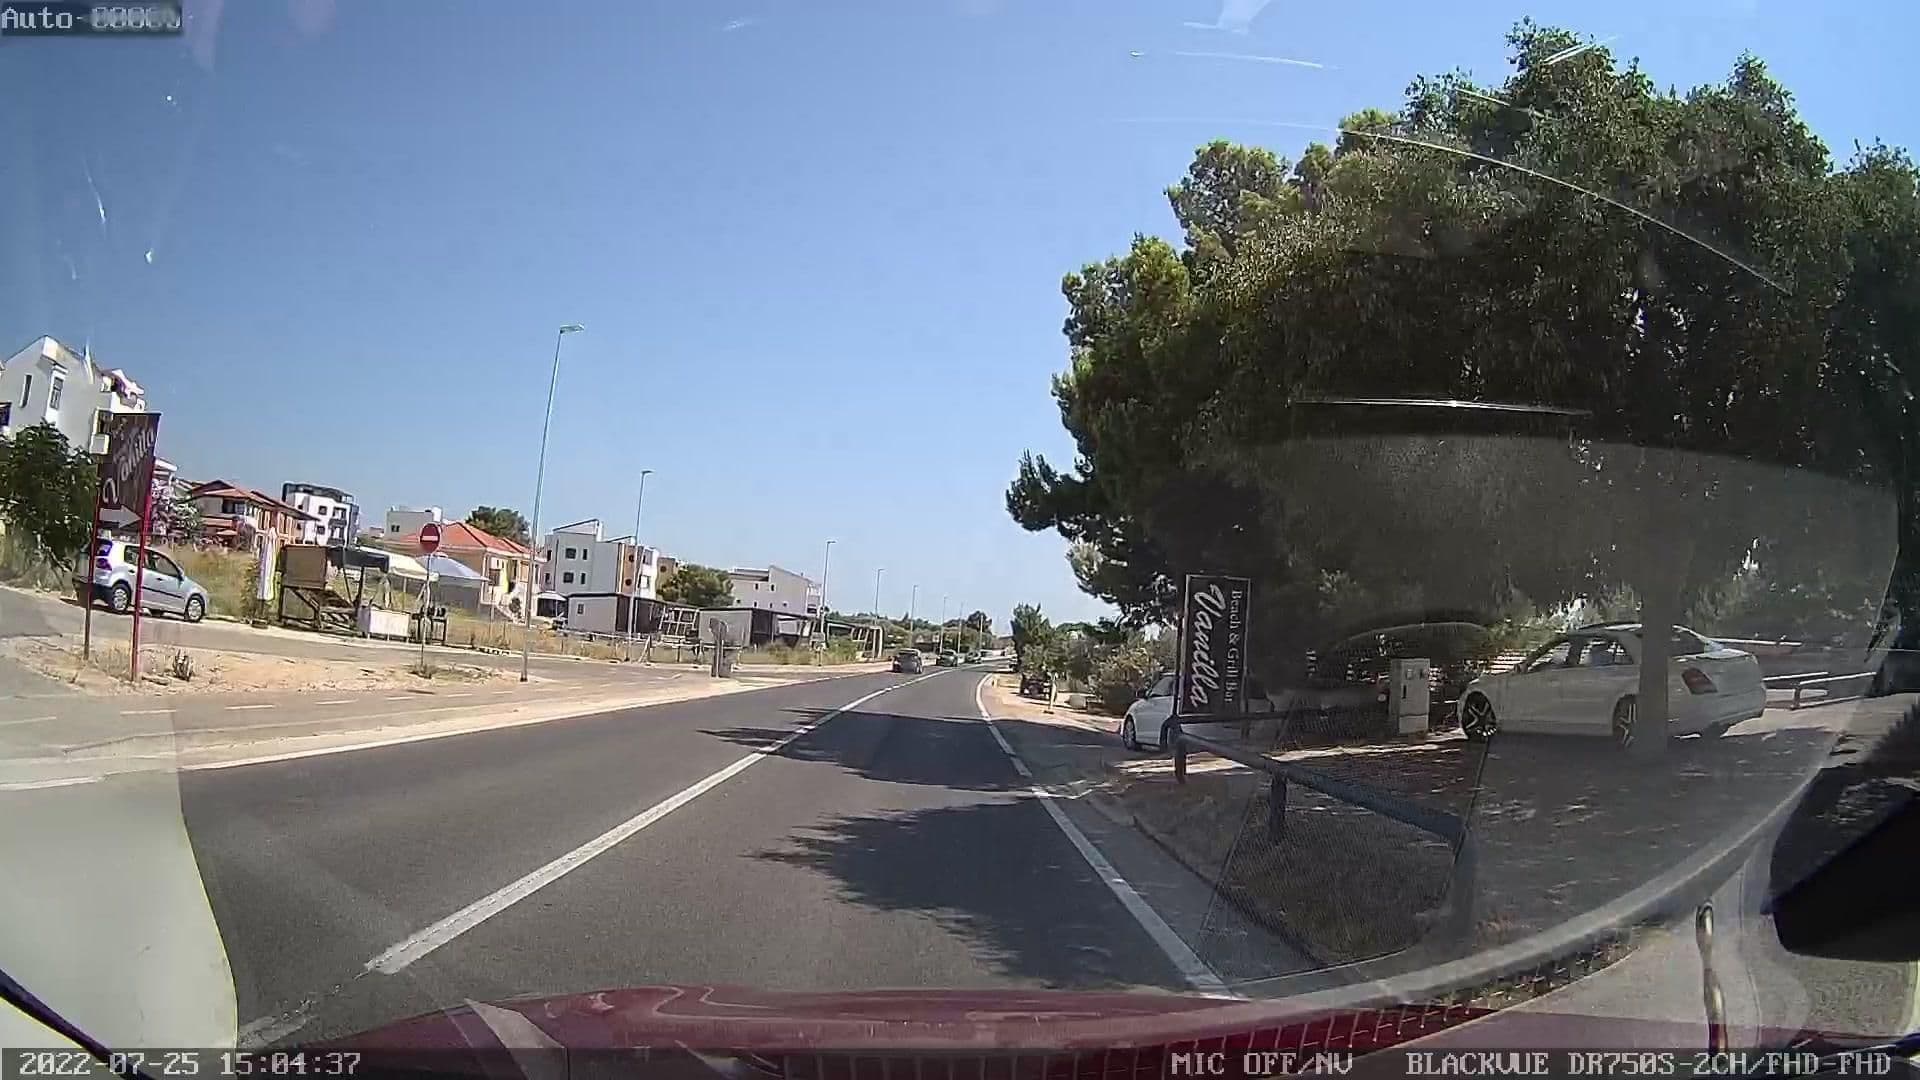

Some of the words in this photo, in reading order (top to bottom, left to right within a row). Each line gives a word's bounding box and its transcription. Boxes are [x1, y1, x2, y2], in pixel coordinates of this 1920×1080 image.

[1229, 590, 1243, 629] Beach
[1190, 583, 1227, 708] Vanilla
[1228, 633, 1241, 645] &
[1225, 648, 1240, 678] Grill
[1224, 682, 1238, 702] Bar
